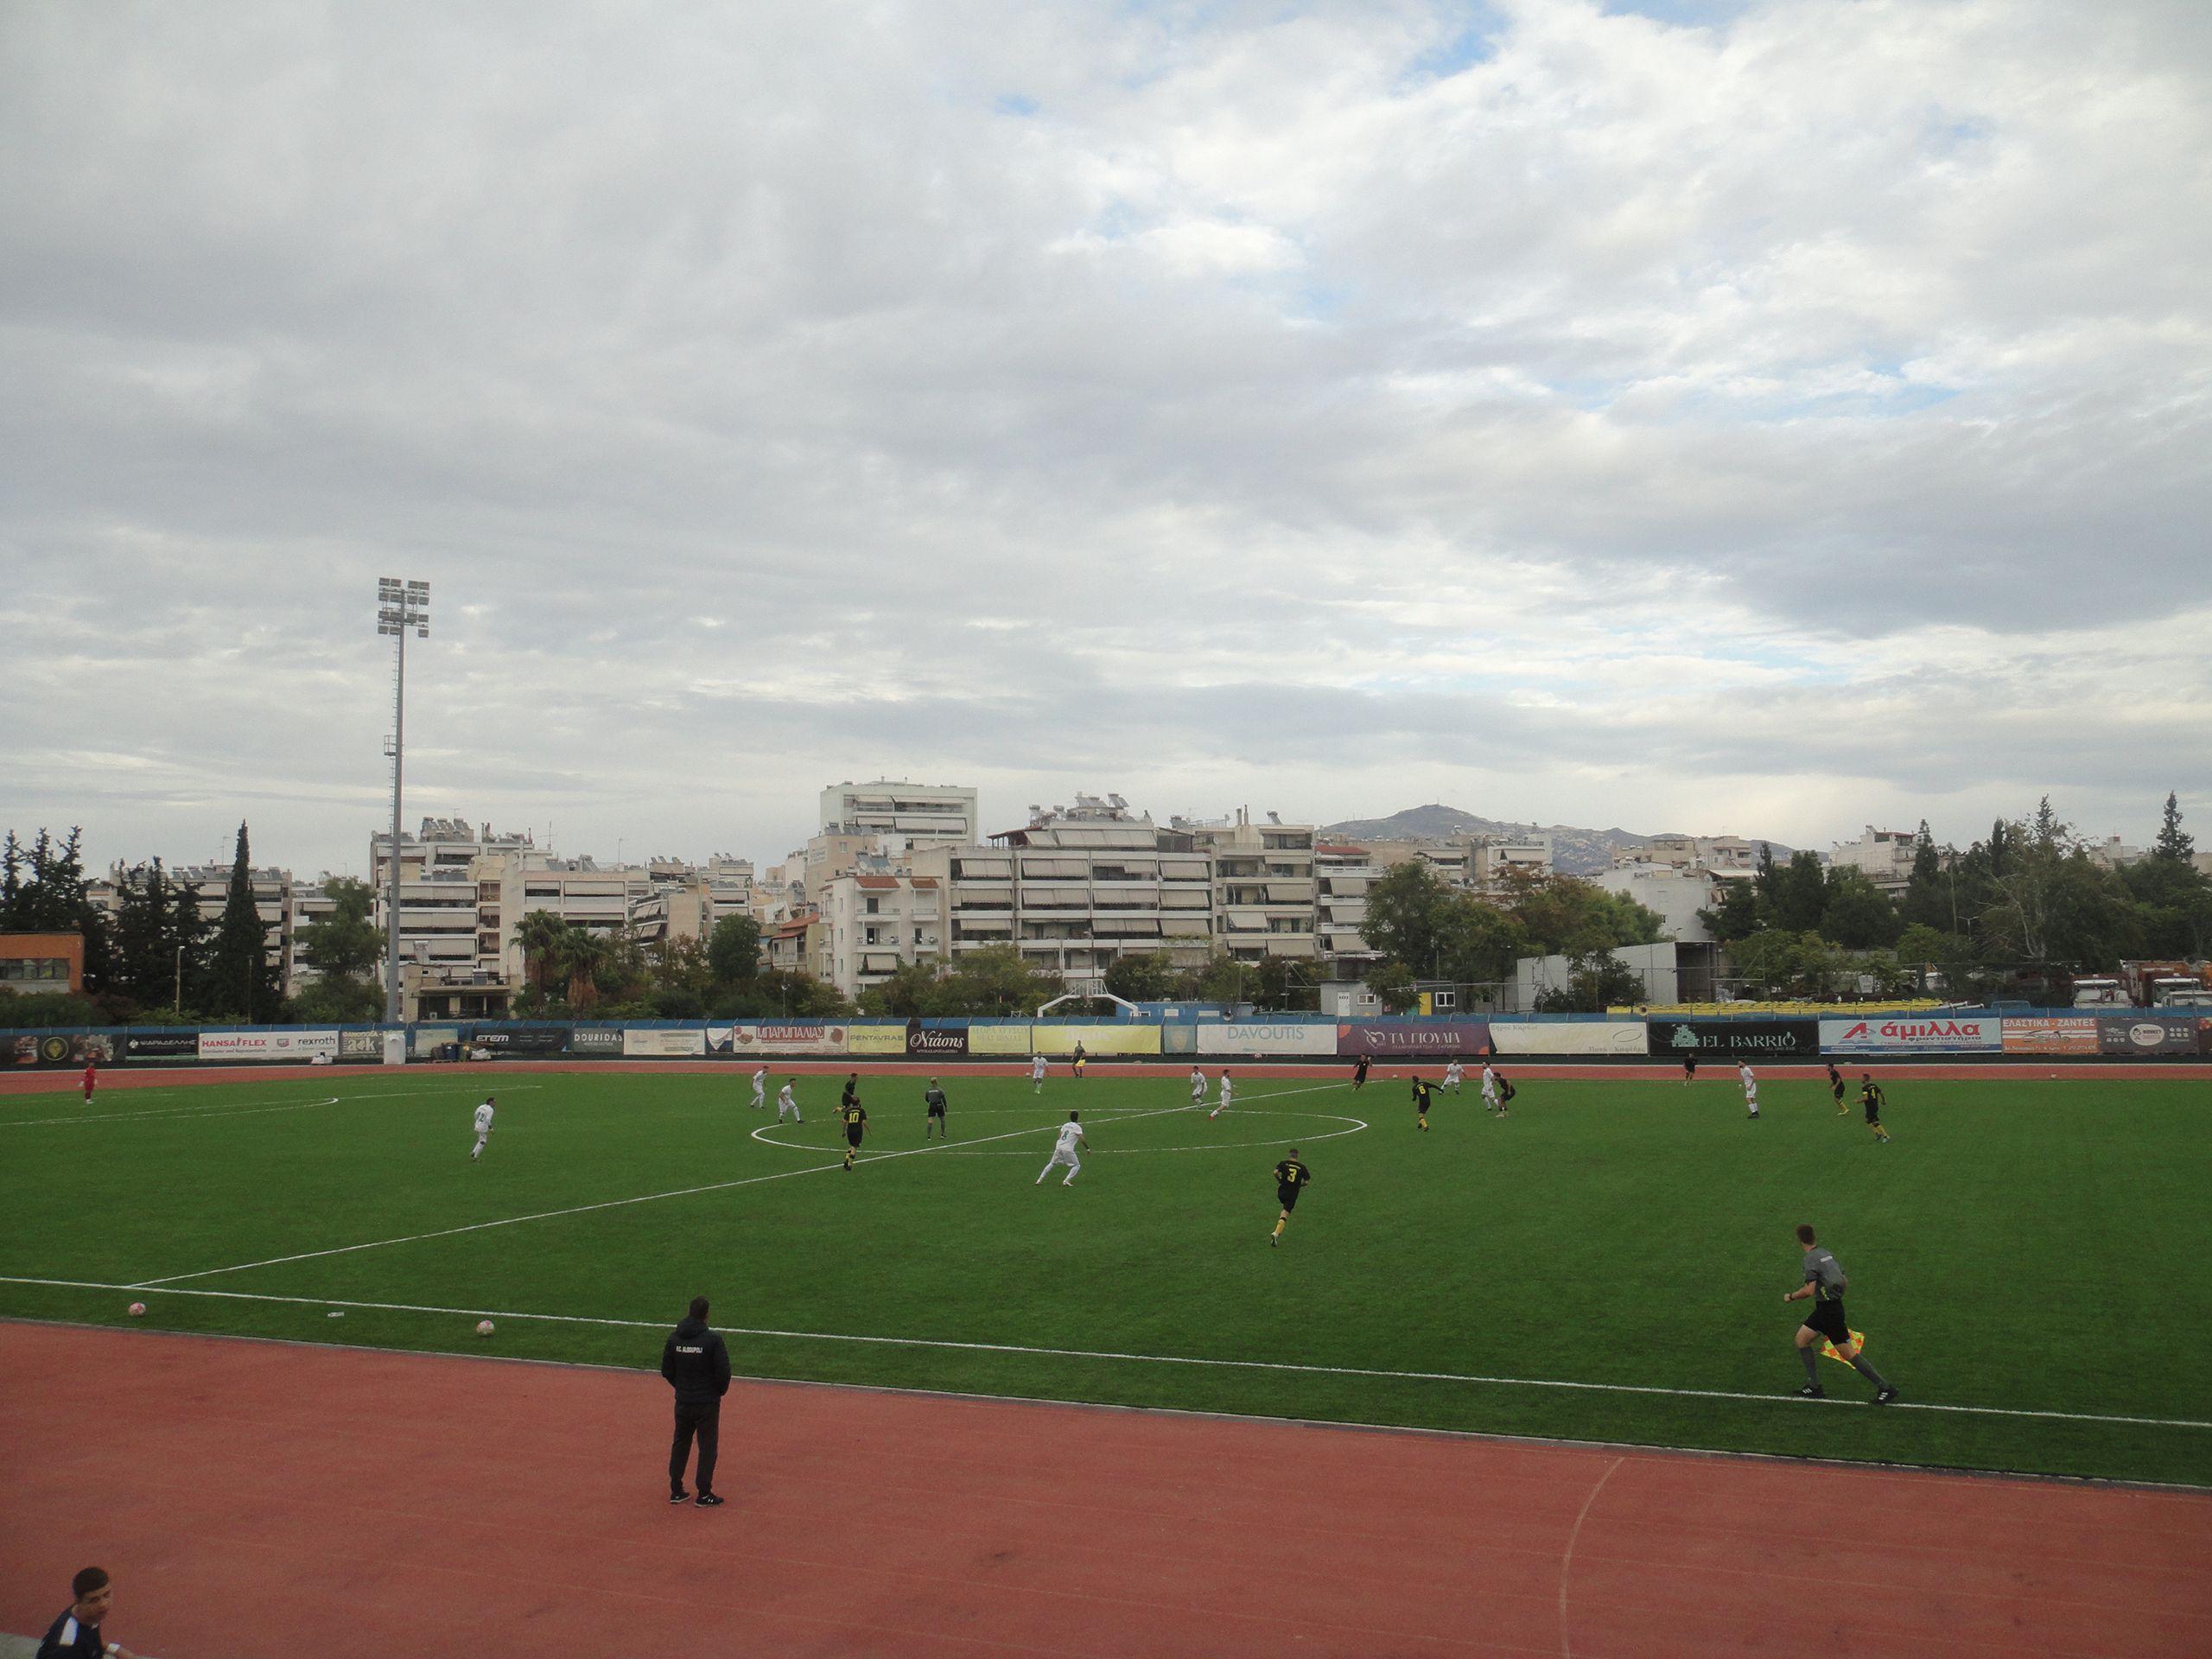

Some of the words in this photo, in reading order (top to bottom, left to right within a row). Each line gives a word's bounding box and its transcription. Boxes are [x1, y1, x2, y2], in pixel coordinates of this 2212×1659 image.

[2003, 1019, 2050, 1027] ΕΛΑΣΤΙΚΑ
[2057, 1018, 2095, 1027] ΖΑΝΤΕΣ
[757, 1027, 824, 1039] ΜΠΑΡΜΠΑΛΙΑΣ
[1227, 1026, 1305, 1040] DAVOUTIS
[1880, 1020, 1980, 1040] άμιλλα
[298, 1036, 335, 1046] rexroth
[575, 1033, 622, 1042] DOURIDAS
[1389, 1033, 1405, 1044] ΤΑ
[1411, 1032, 1460, 1044] ΓΙΟΥΛΙΑ
[1703, 1036, 1725, 1047] EL
[849, 1112, 860, 1123] 10
[1062, 1130, 1069, 1141] 8
[1287, 1167, 1297, 1183] 3
